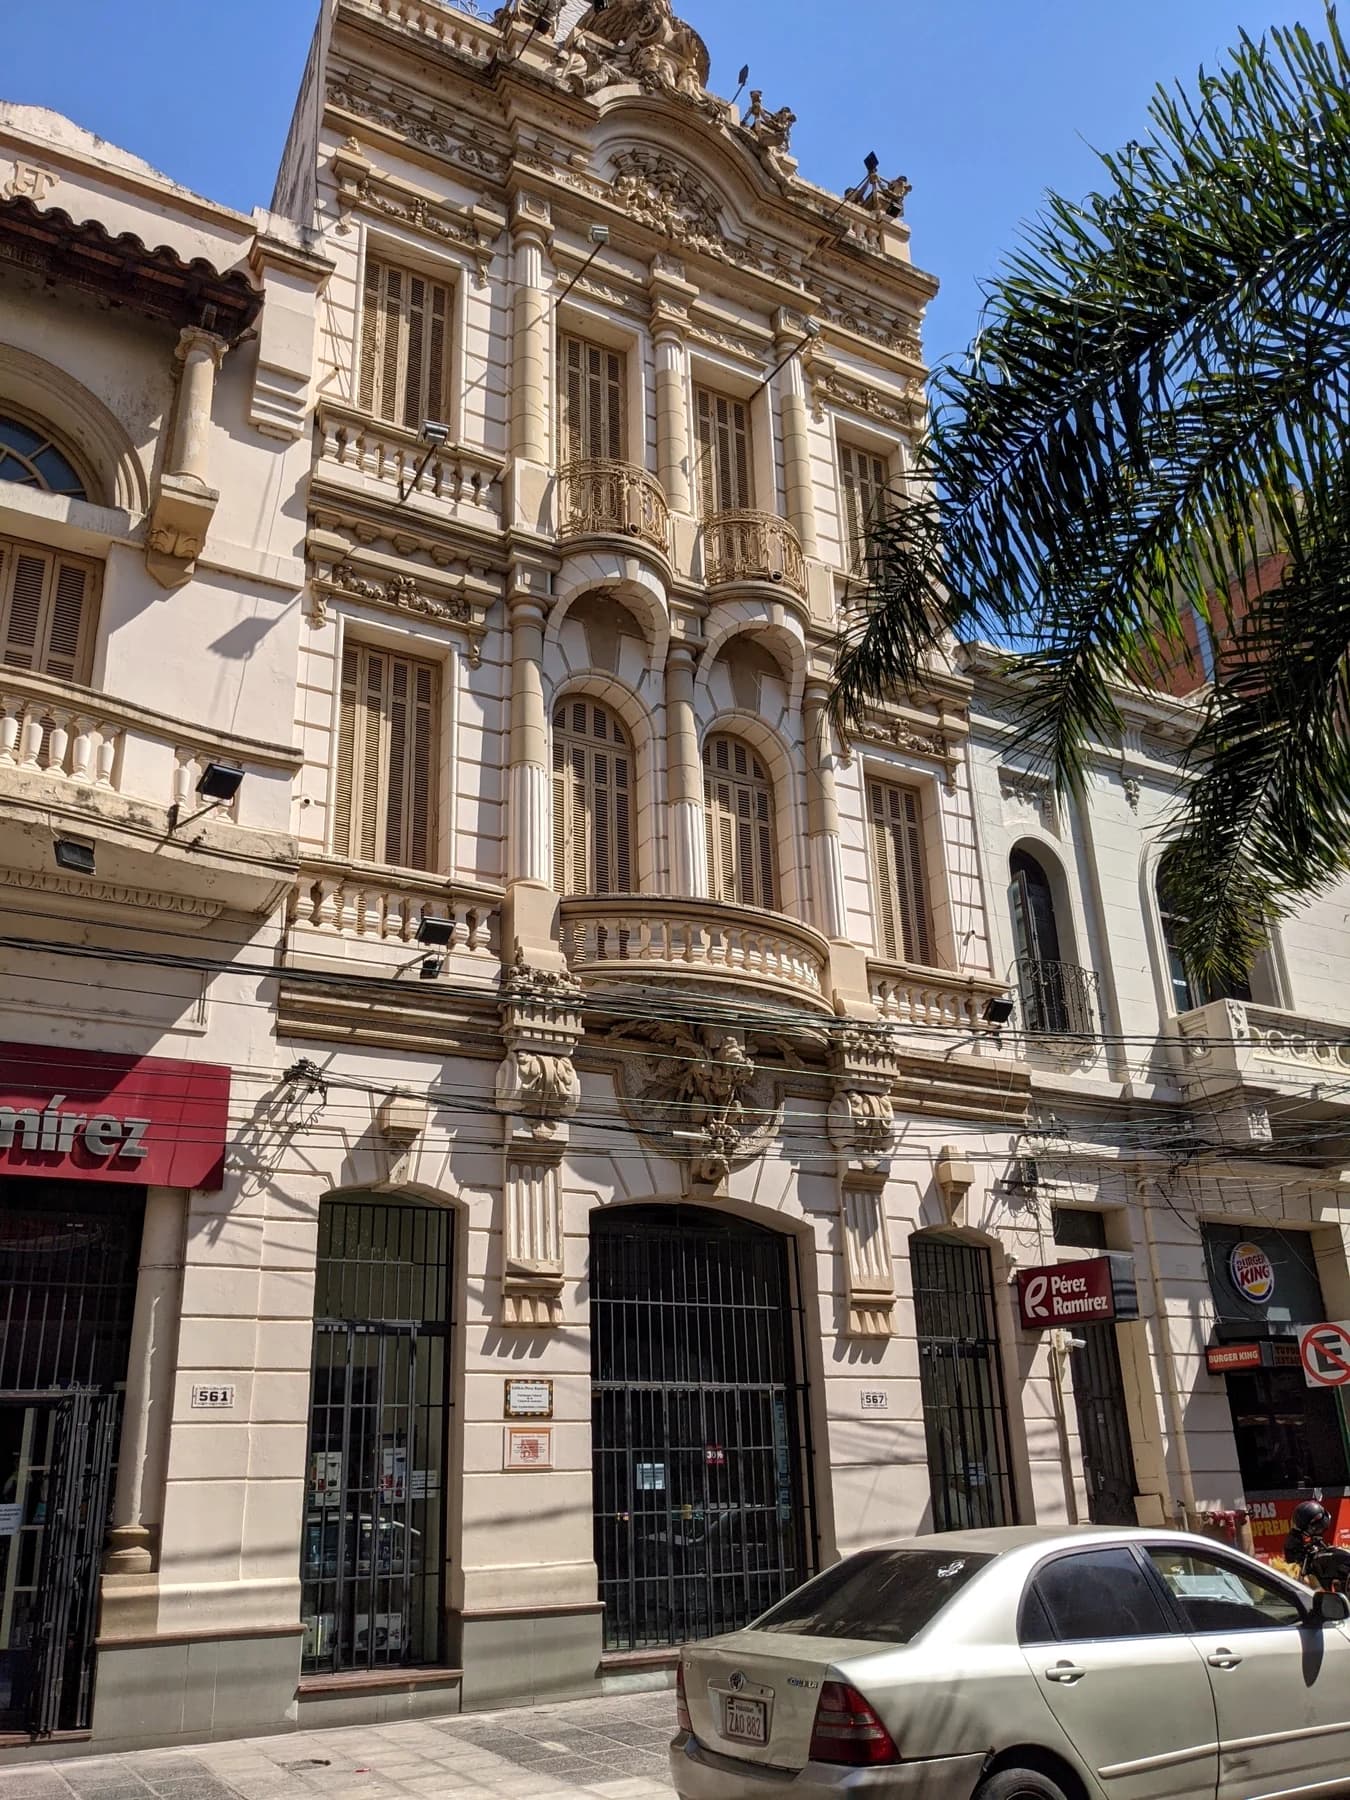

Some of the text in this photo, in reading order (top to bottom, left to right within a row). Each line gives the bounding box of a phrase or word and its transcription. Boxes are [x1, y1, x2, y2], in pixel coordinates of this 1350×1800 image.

[1236, 1254, 1265, 1271] BURGER
[1240, 1264, 1270, 1286] KING
[1050, 1275, 1087, 1295] Pérez
[1052, 1293, 1108, 1316] Ramírez
[1208, 1350, 1259, 1363] BURGER KING
[1312, 1335, 1347, 1372] E
[199, 1391, 229, 1402] 561
[865, 1394, 885, 1404] 567
